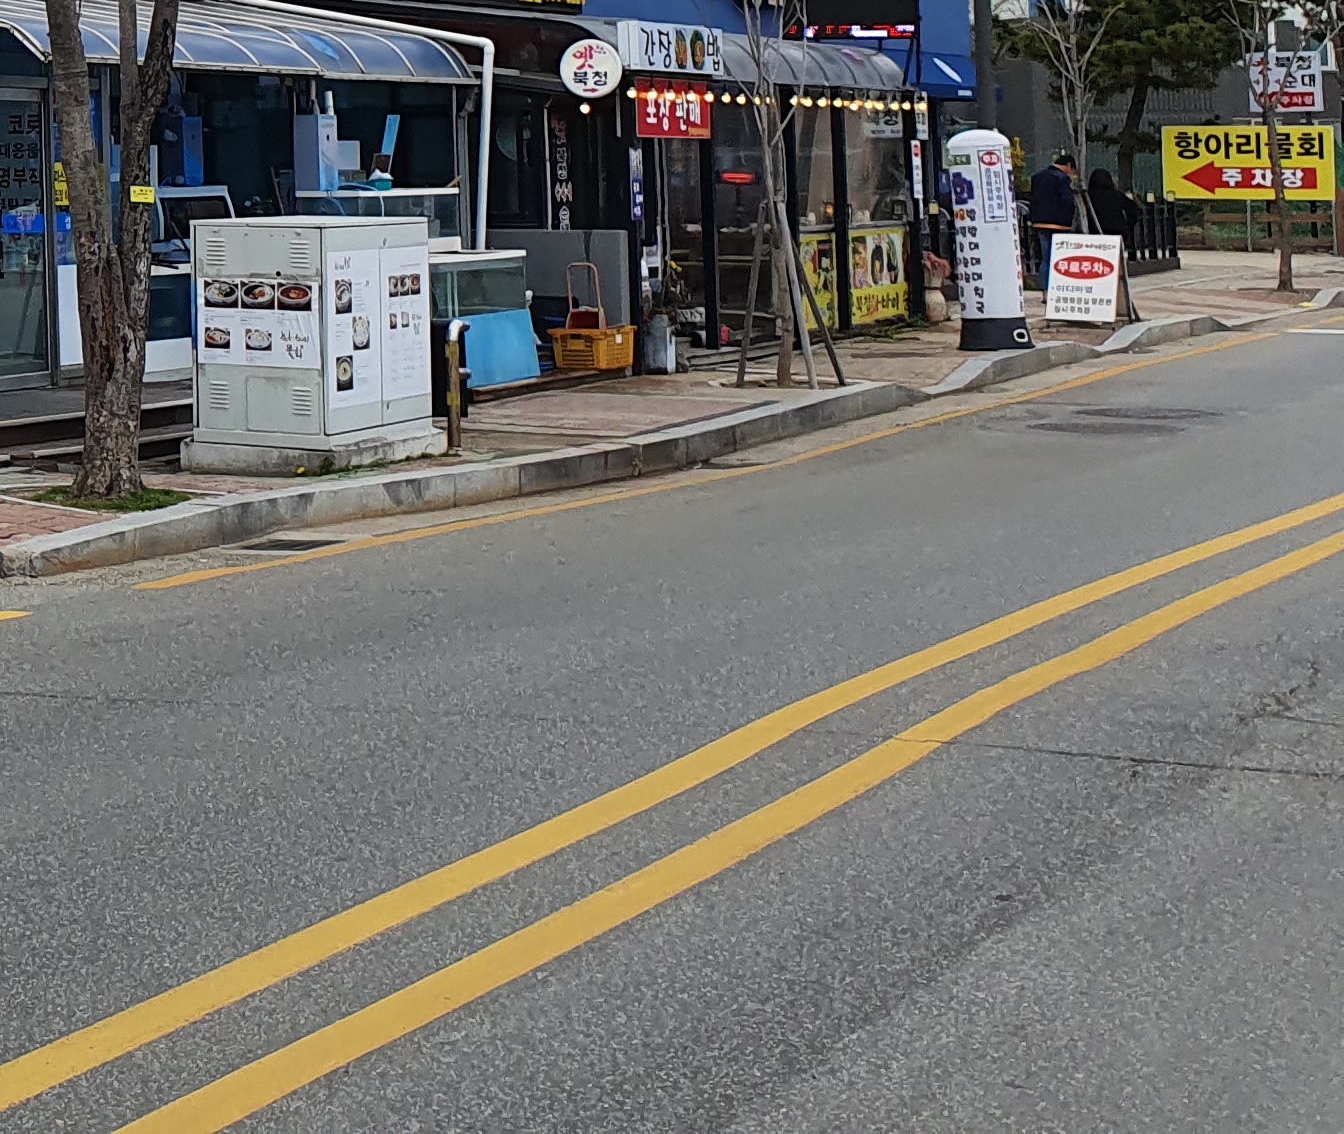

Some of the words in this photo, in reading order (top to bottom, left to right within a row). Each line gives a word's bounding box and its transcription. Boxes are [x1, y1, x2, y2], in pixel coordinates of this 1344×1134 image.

[572, 44, 594, 70] 옛
[572, 70, 608, 86] 북청
[675, 90, 701, 131] 판매
[1174, 132, 1324, 160] 항아리물회
[1222, 168, 1304, 188] 주차장
